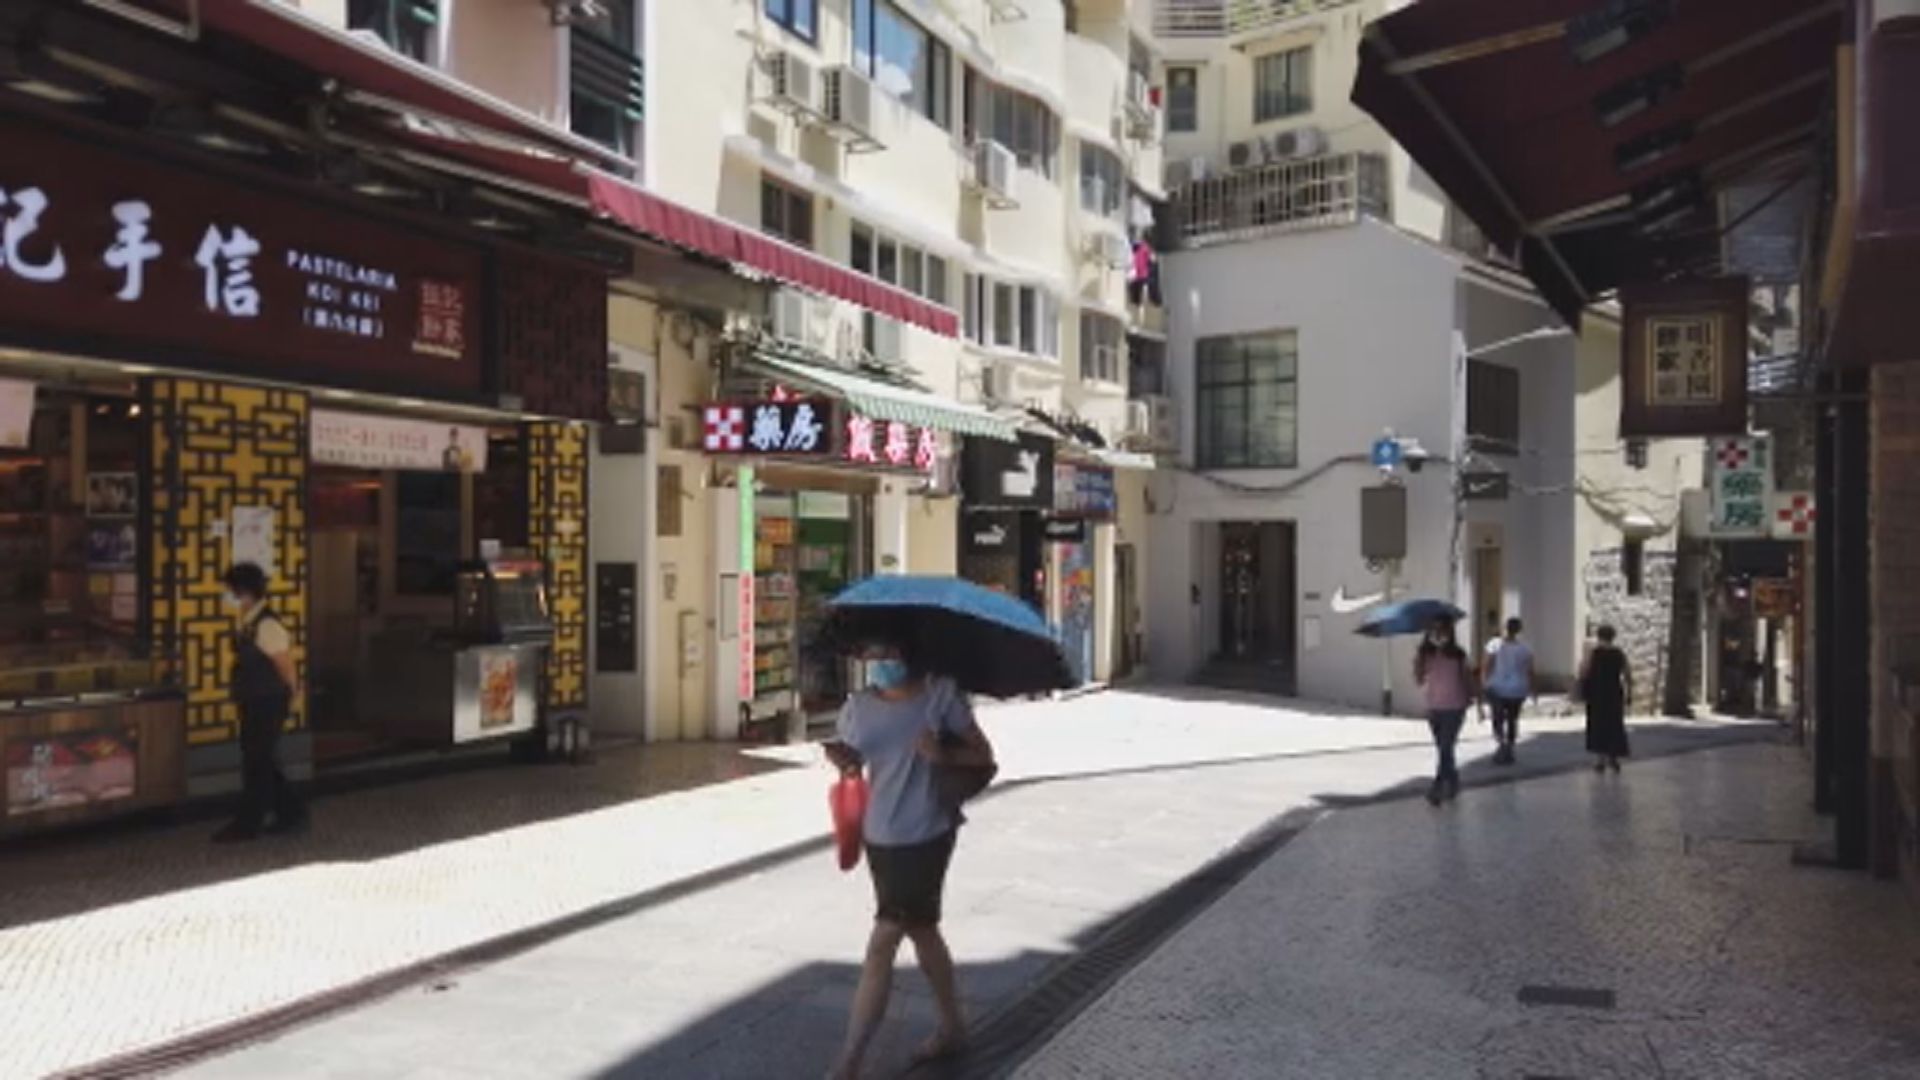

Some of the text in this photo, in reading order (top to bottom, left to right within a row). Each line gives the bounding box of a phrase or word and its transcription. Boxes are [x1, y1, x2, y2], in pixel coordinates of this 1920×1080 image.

[287, 249, 397, 290] PASTELARIA
[306, 280, 380, 312] KOI KEI
